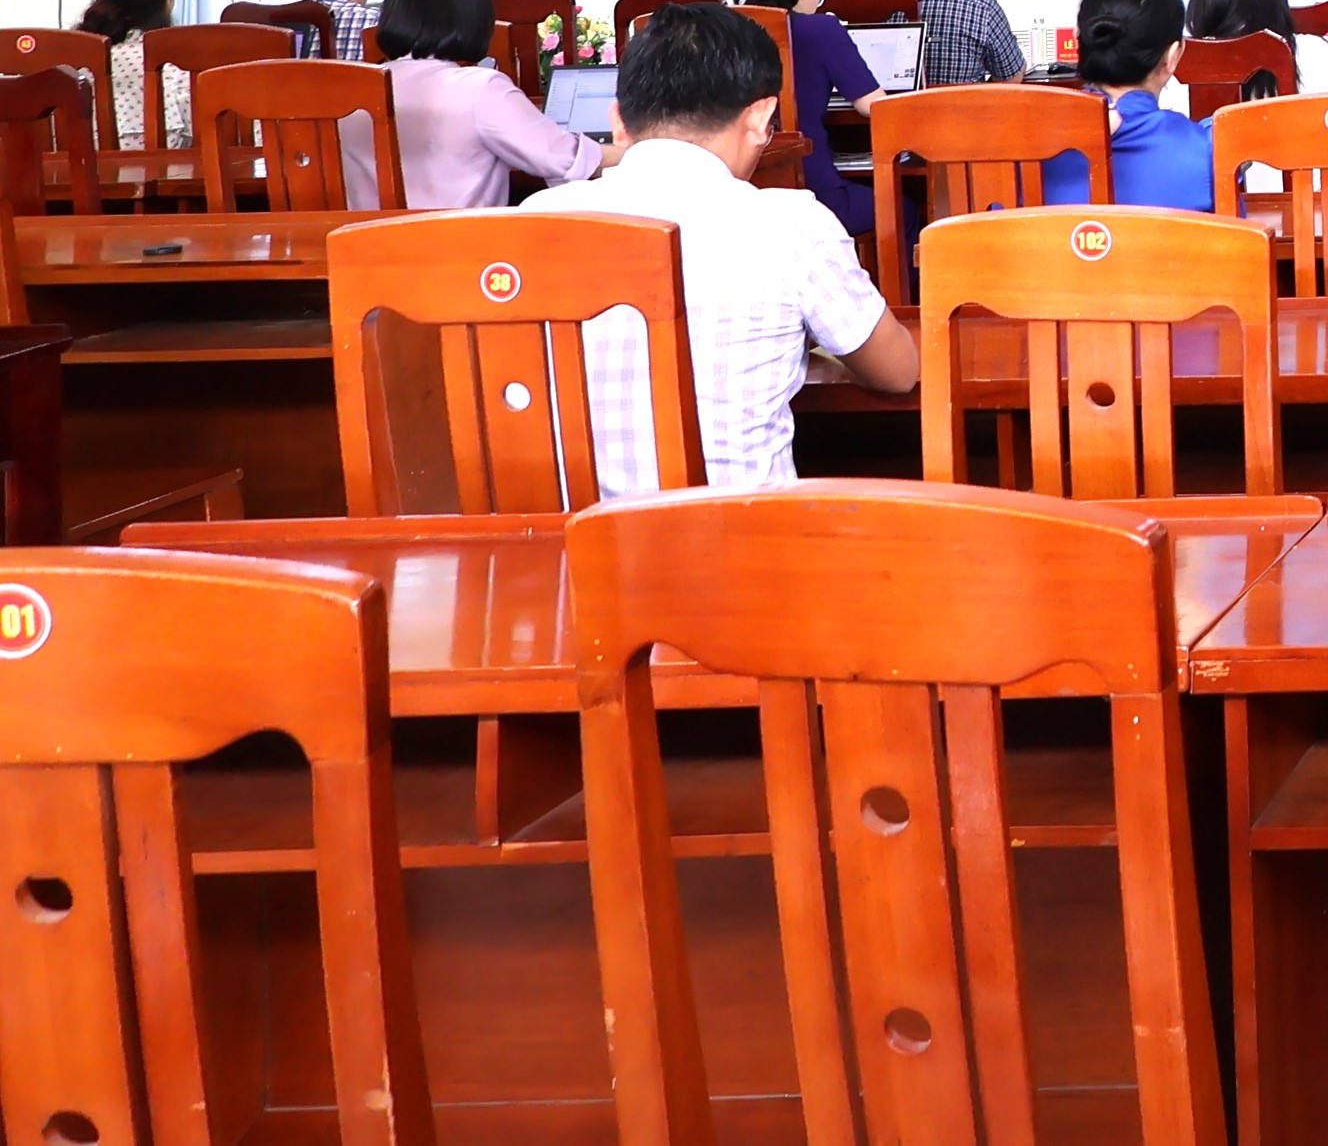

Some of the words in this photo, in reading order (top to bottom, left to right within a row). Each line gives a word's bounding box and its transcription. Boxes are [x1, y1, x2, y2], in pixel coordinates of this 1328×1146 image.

[1078, 232, 1106, 250] 102
[490, 273, 511, 291] 38
[0, 604, 36, 639] 01
